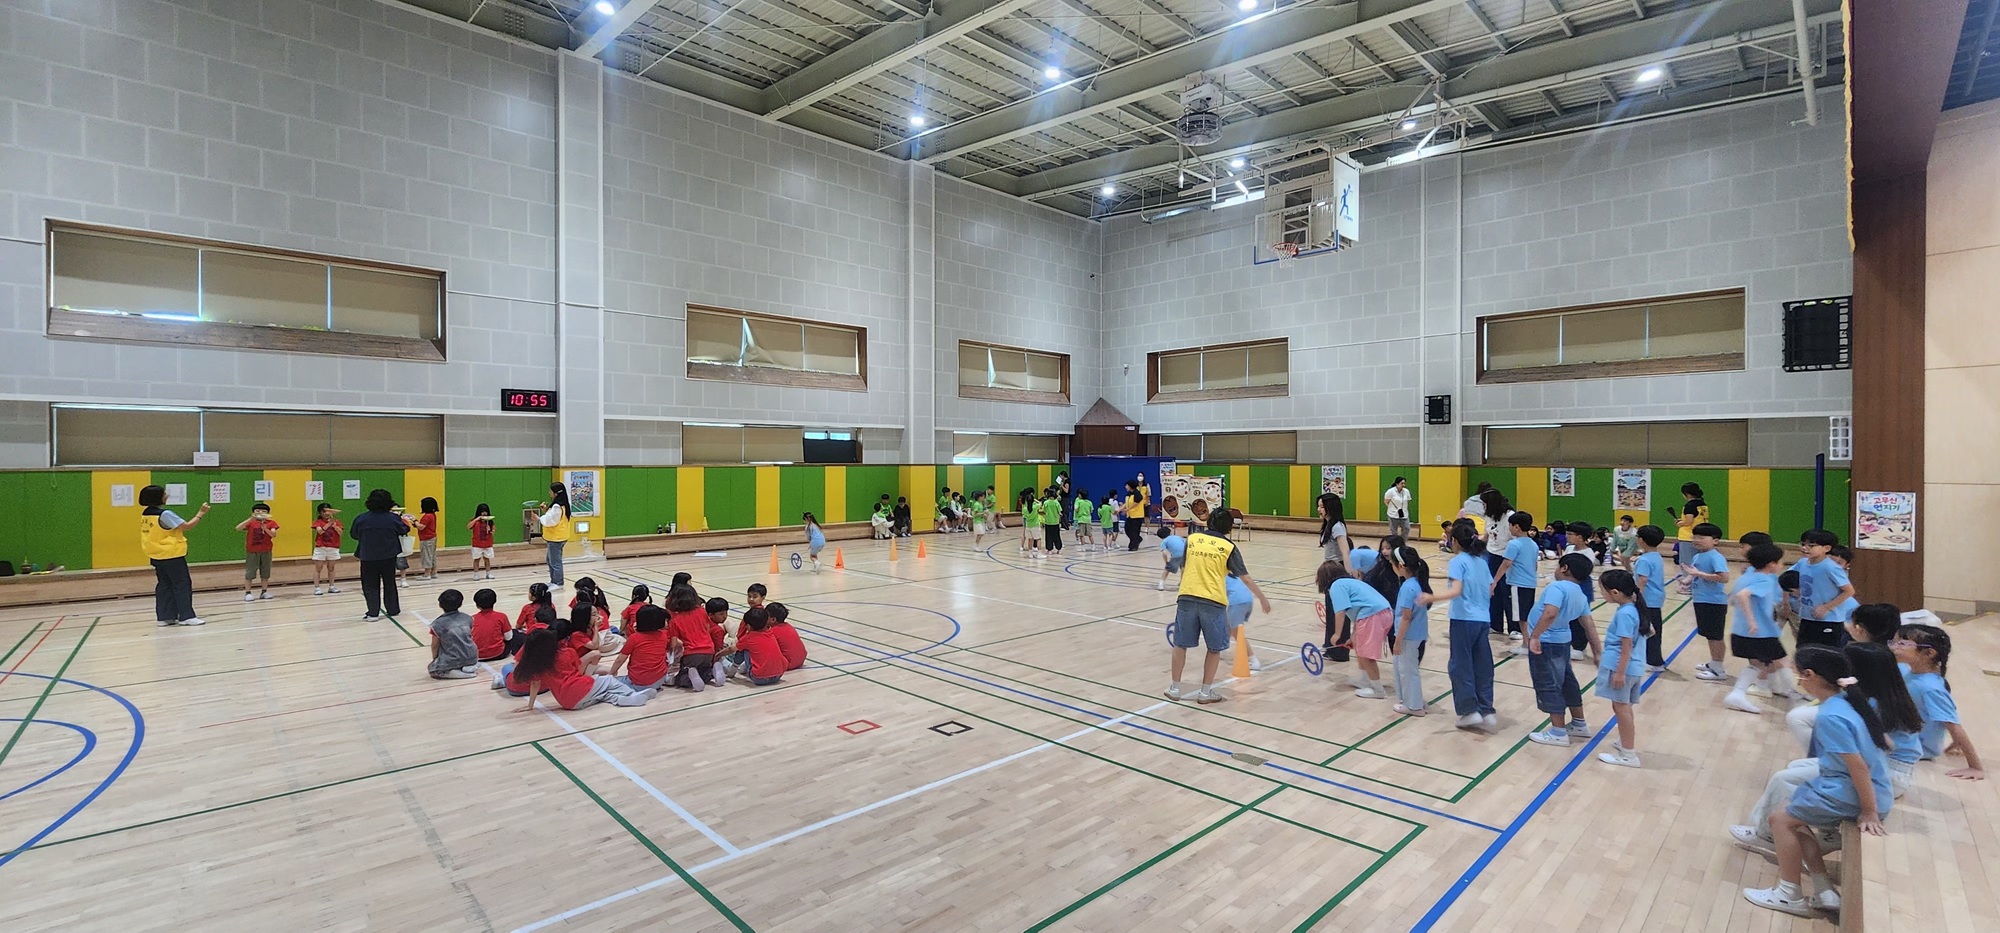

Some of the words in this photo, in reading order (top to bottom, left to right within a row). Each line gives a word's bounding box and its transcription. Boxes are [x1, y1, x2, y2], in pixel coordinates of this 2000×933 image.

[510, 394, 547, 406] 10:55
[256, 482, 271, 497] 리
[1873, 496, 1898, 504] 고무신
